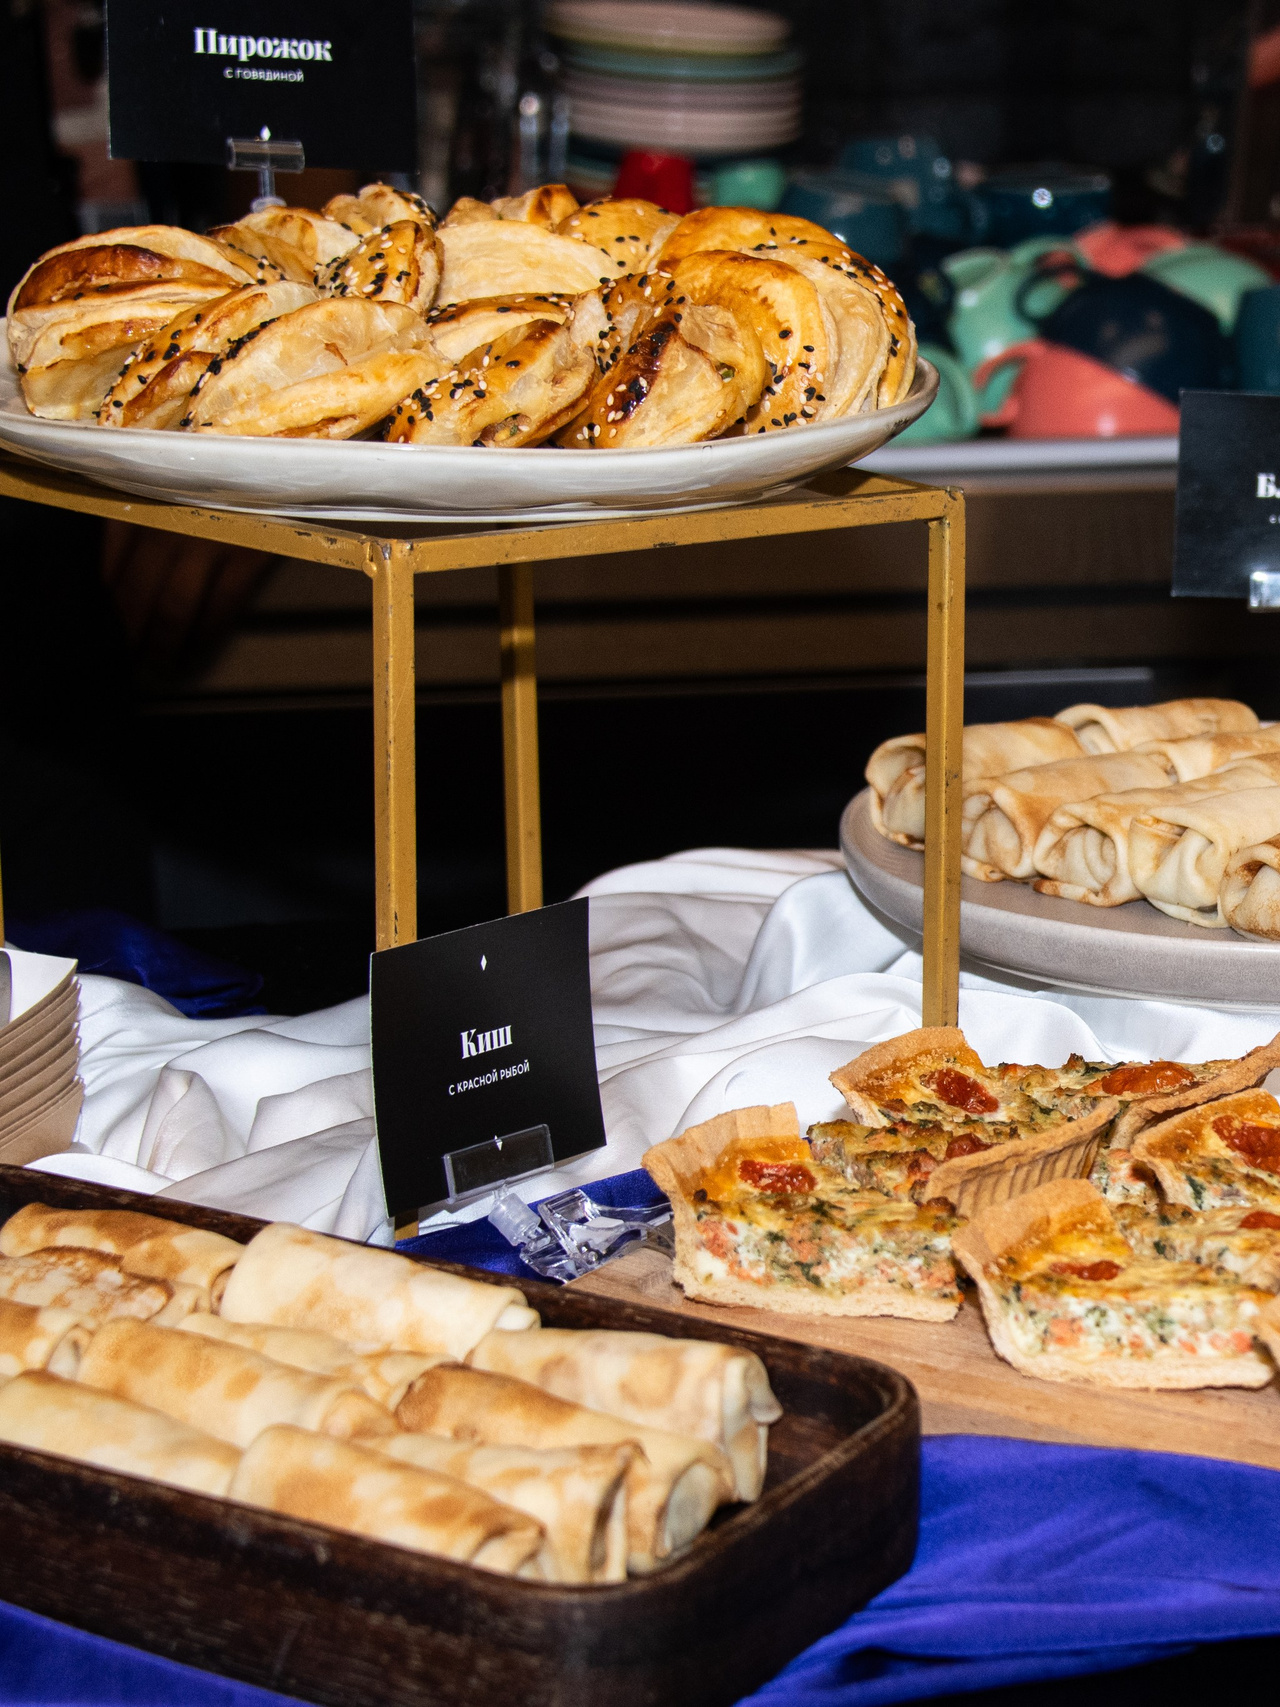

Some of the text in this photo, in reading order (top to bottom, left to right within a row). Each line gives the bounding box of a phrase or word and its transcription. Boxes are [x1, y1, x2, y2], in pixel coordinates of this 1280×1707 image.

[194, 27, 333, 62] Пирожок
[460, 1025, 513, 1060] Киш
[449, 1059, 530, 1096] С КРАСНОЙ РЫБОЙ
